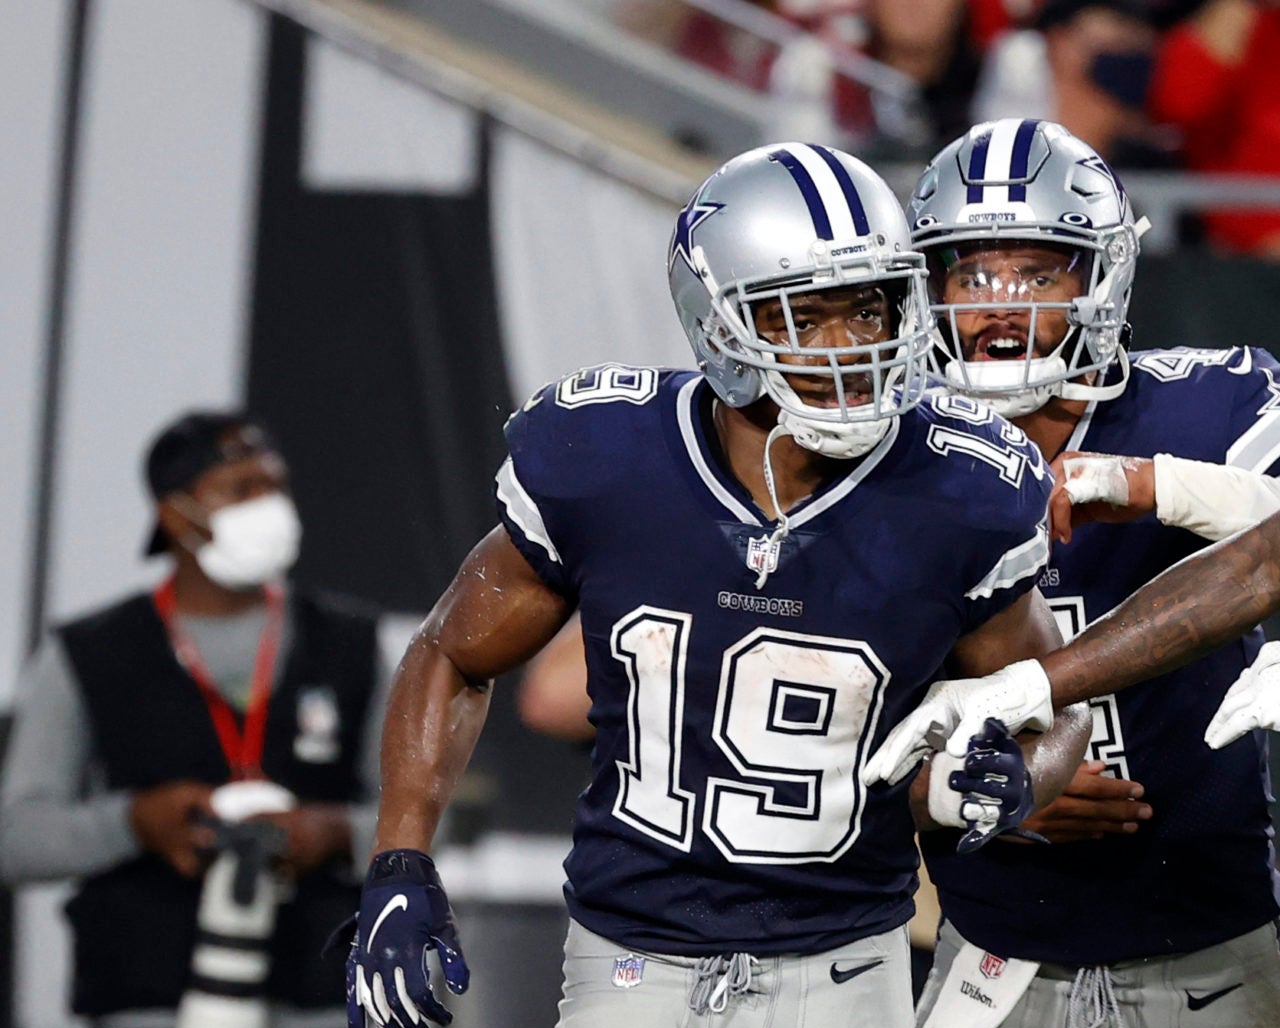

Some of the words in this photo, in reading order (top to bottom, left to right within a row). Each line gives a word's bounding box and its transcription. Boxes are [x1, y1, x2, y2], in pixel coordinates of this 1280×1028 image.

[968, 212, 1017, 223] COWBOYS
[717, 591, 804, 617] COWBOYS
[609, 604, 892, 865] 19
[617, 967, 638, 982] NFL
[982, 953, 1004, 977] NFL
[960, 980, 993, 1008] Wilson
